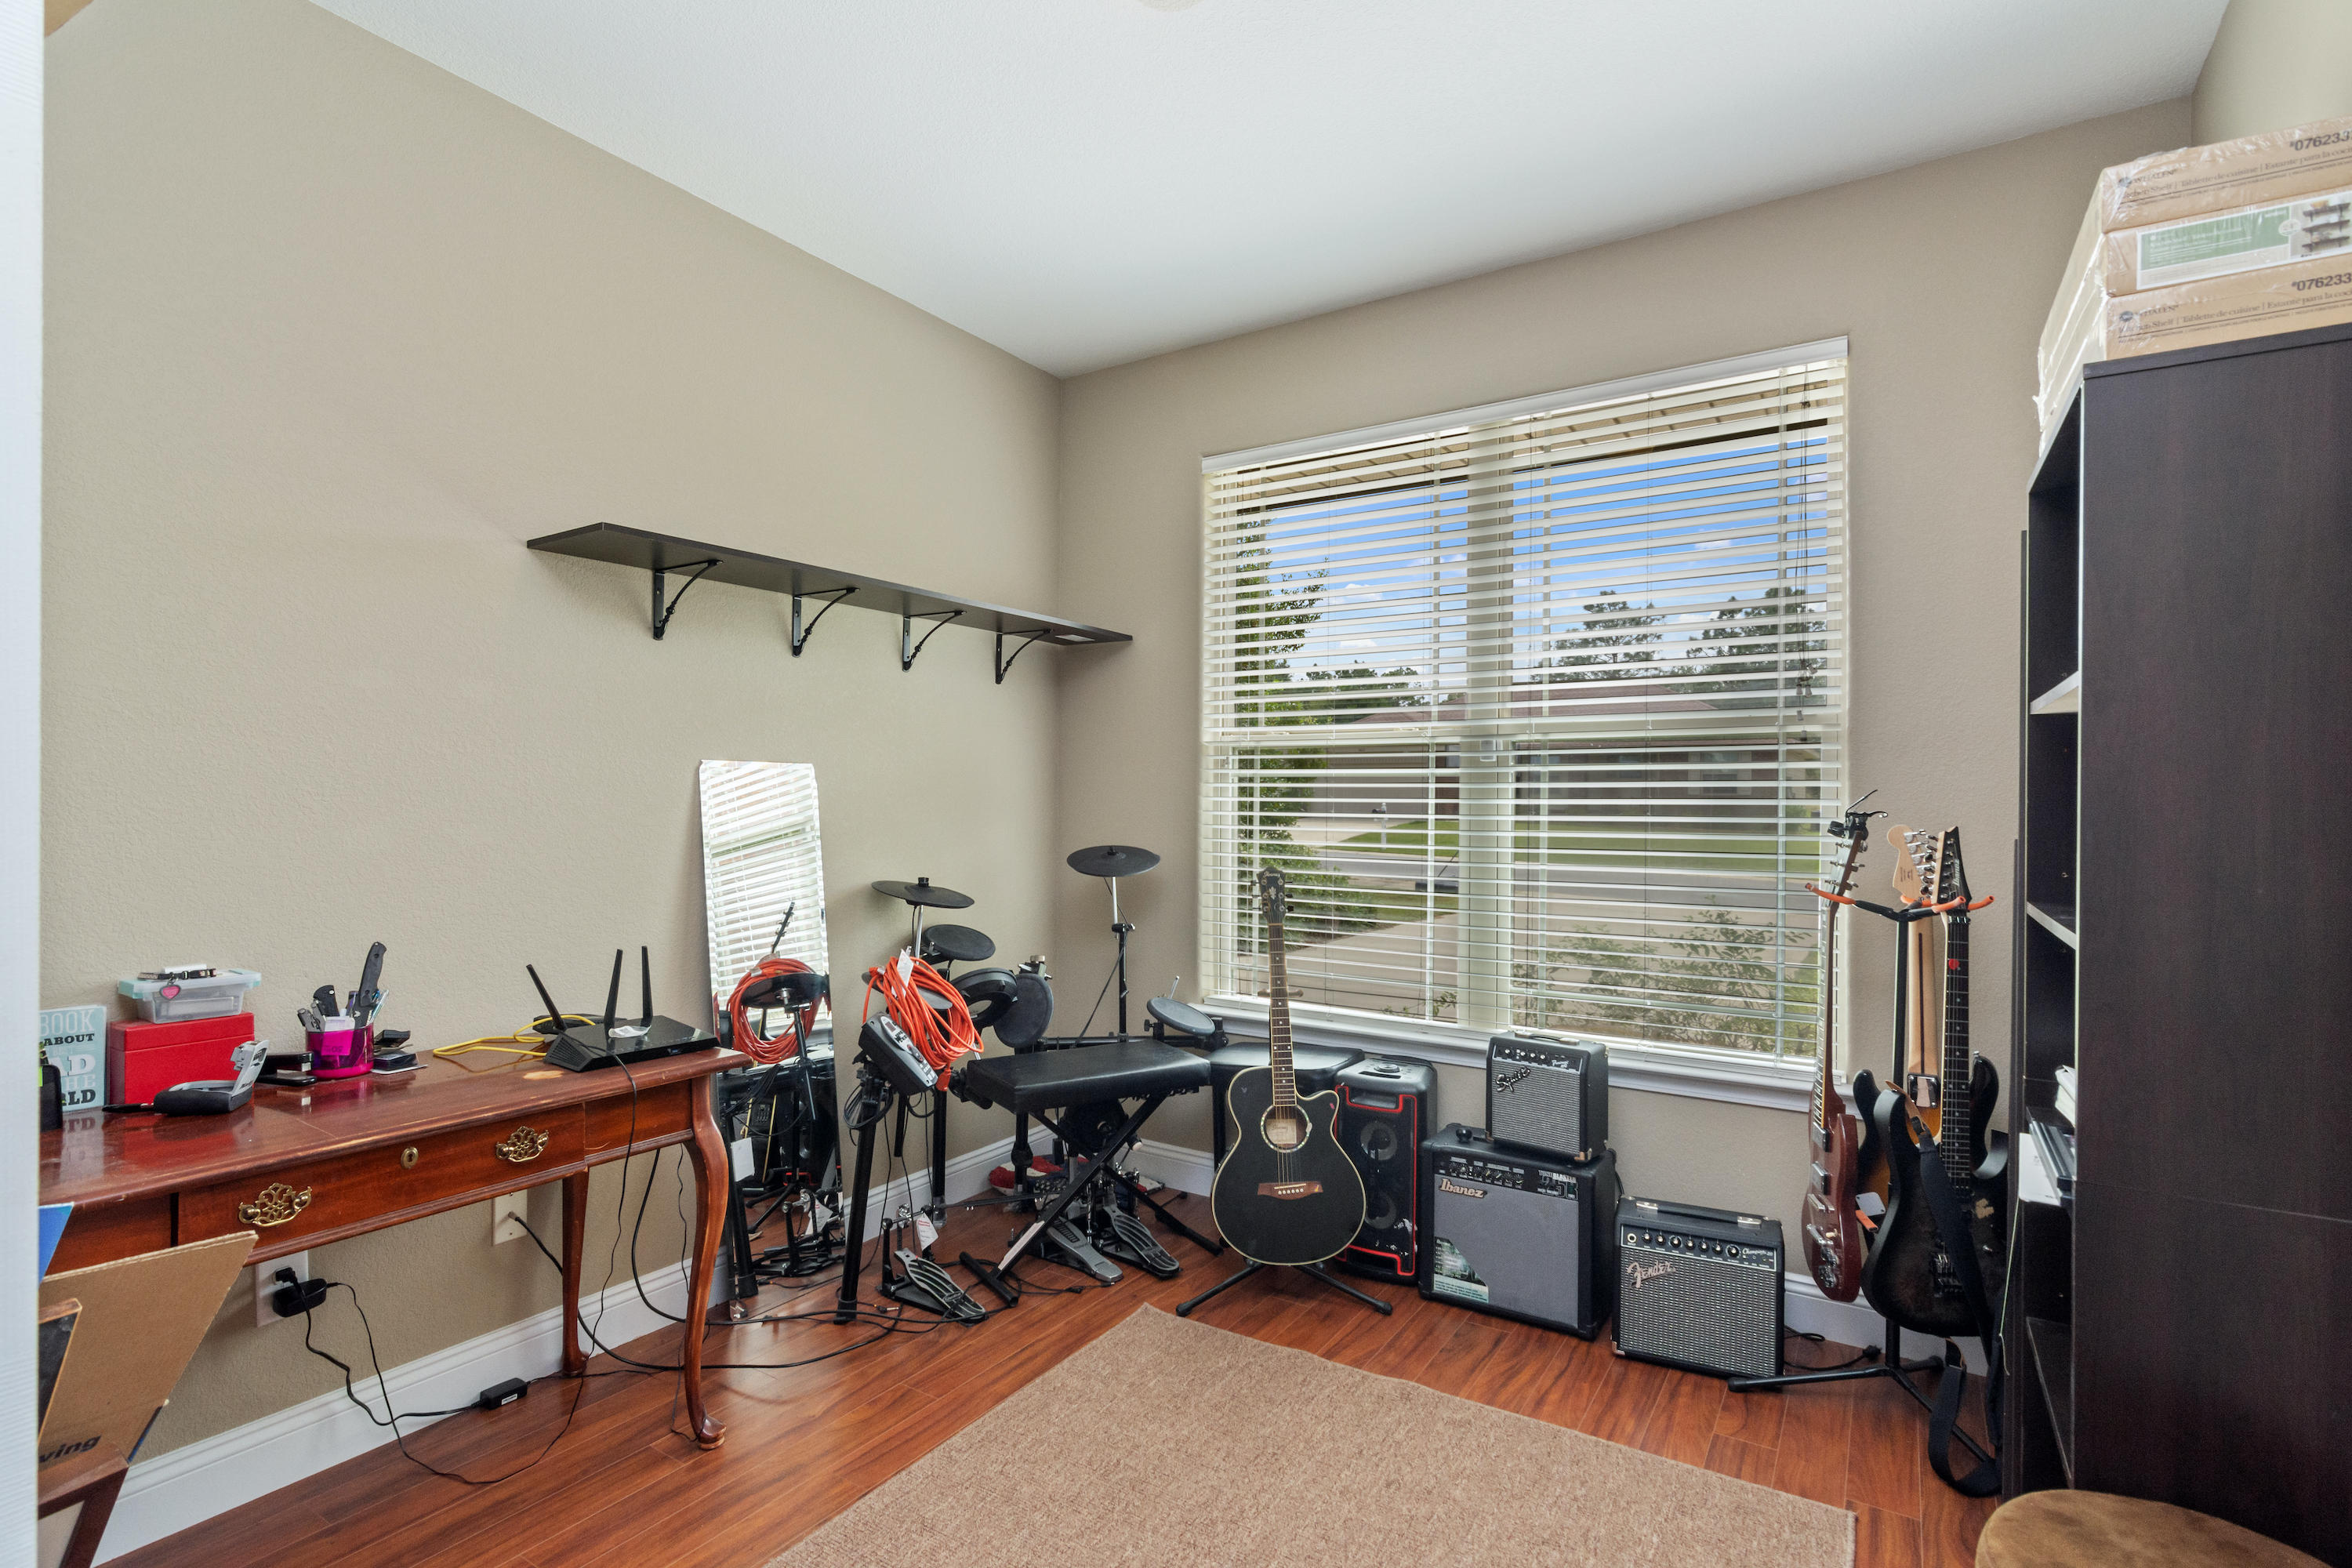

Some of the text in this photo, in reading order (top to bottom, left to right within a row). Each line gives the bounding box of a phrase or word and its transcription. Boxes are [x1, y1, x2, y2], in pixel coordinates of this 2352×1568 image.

[2152, 318, 2172, 328] Shelf
[39, 1009, 95, 1036] BOOK
[44, 1033, 95, 1046] ABOUT
[1439, 1178, 1486, 1199] Ibanez
[1626, 1260, 1677, 1289] Fender
